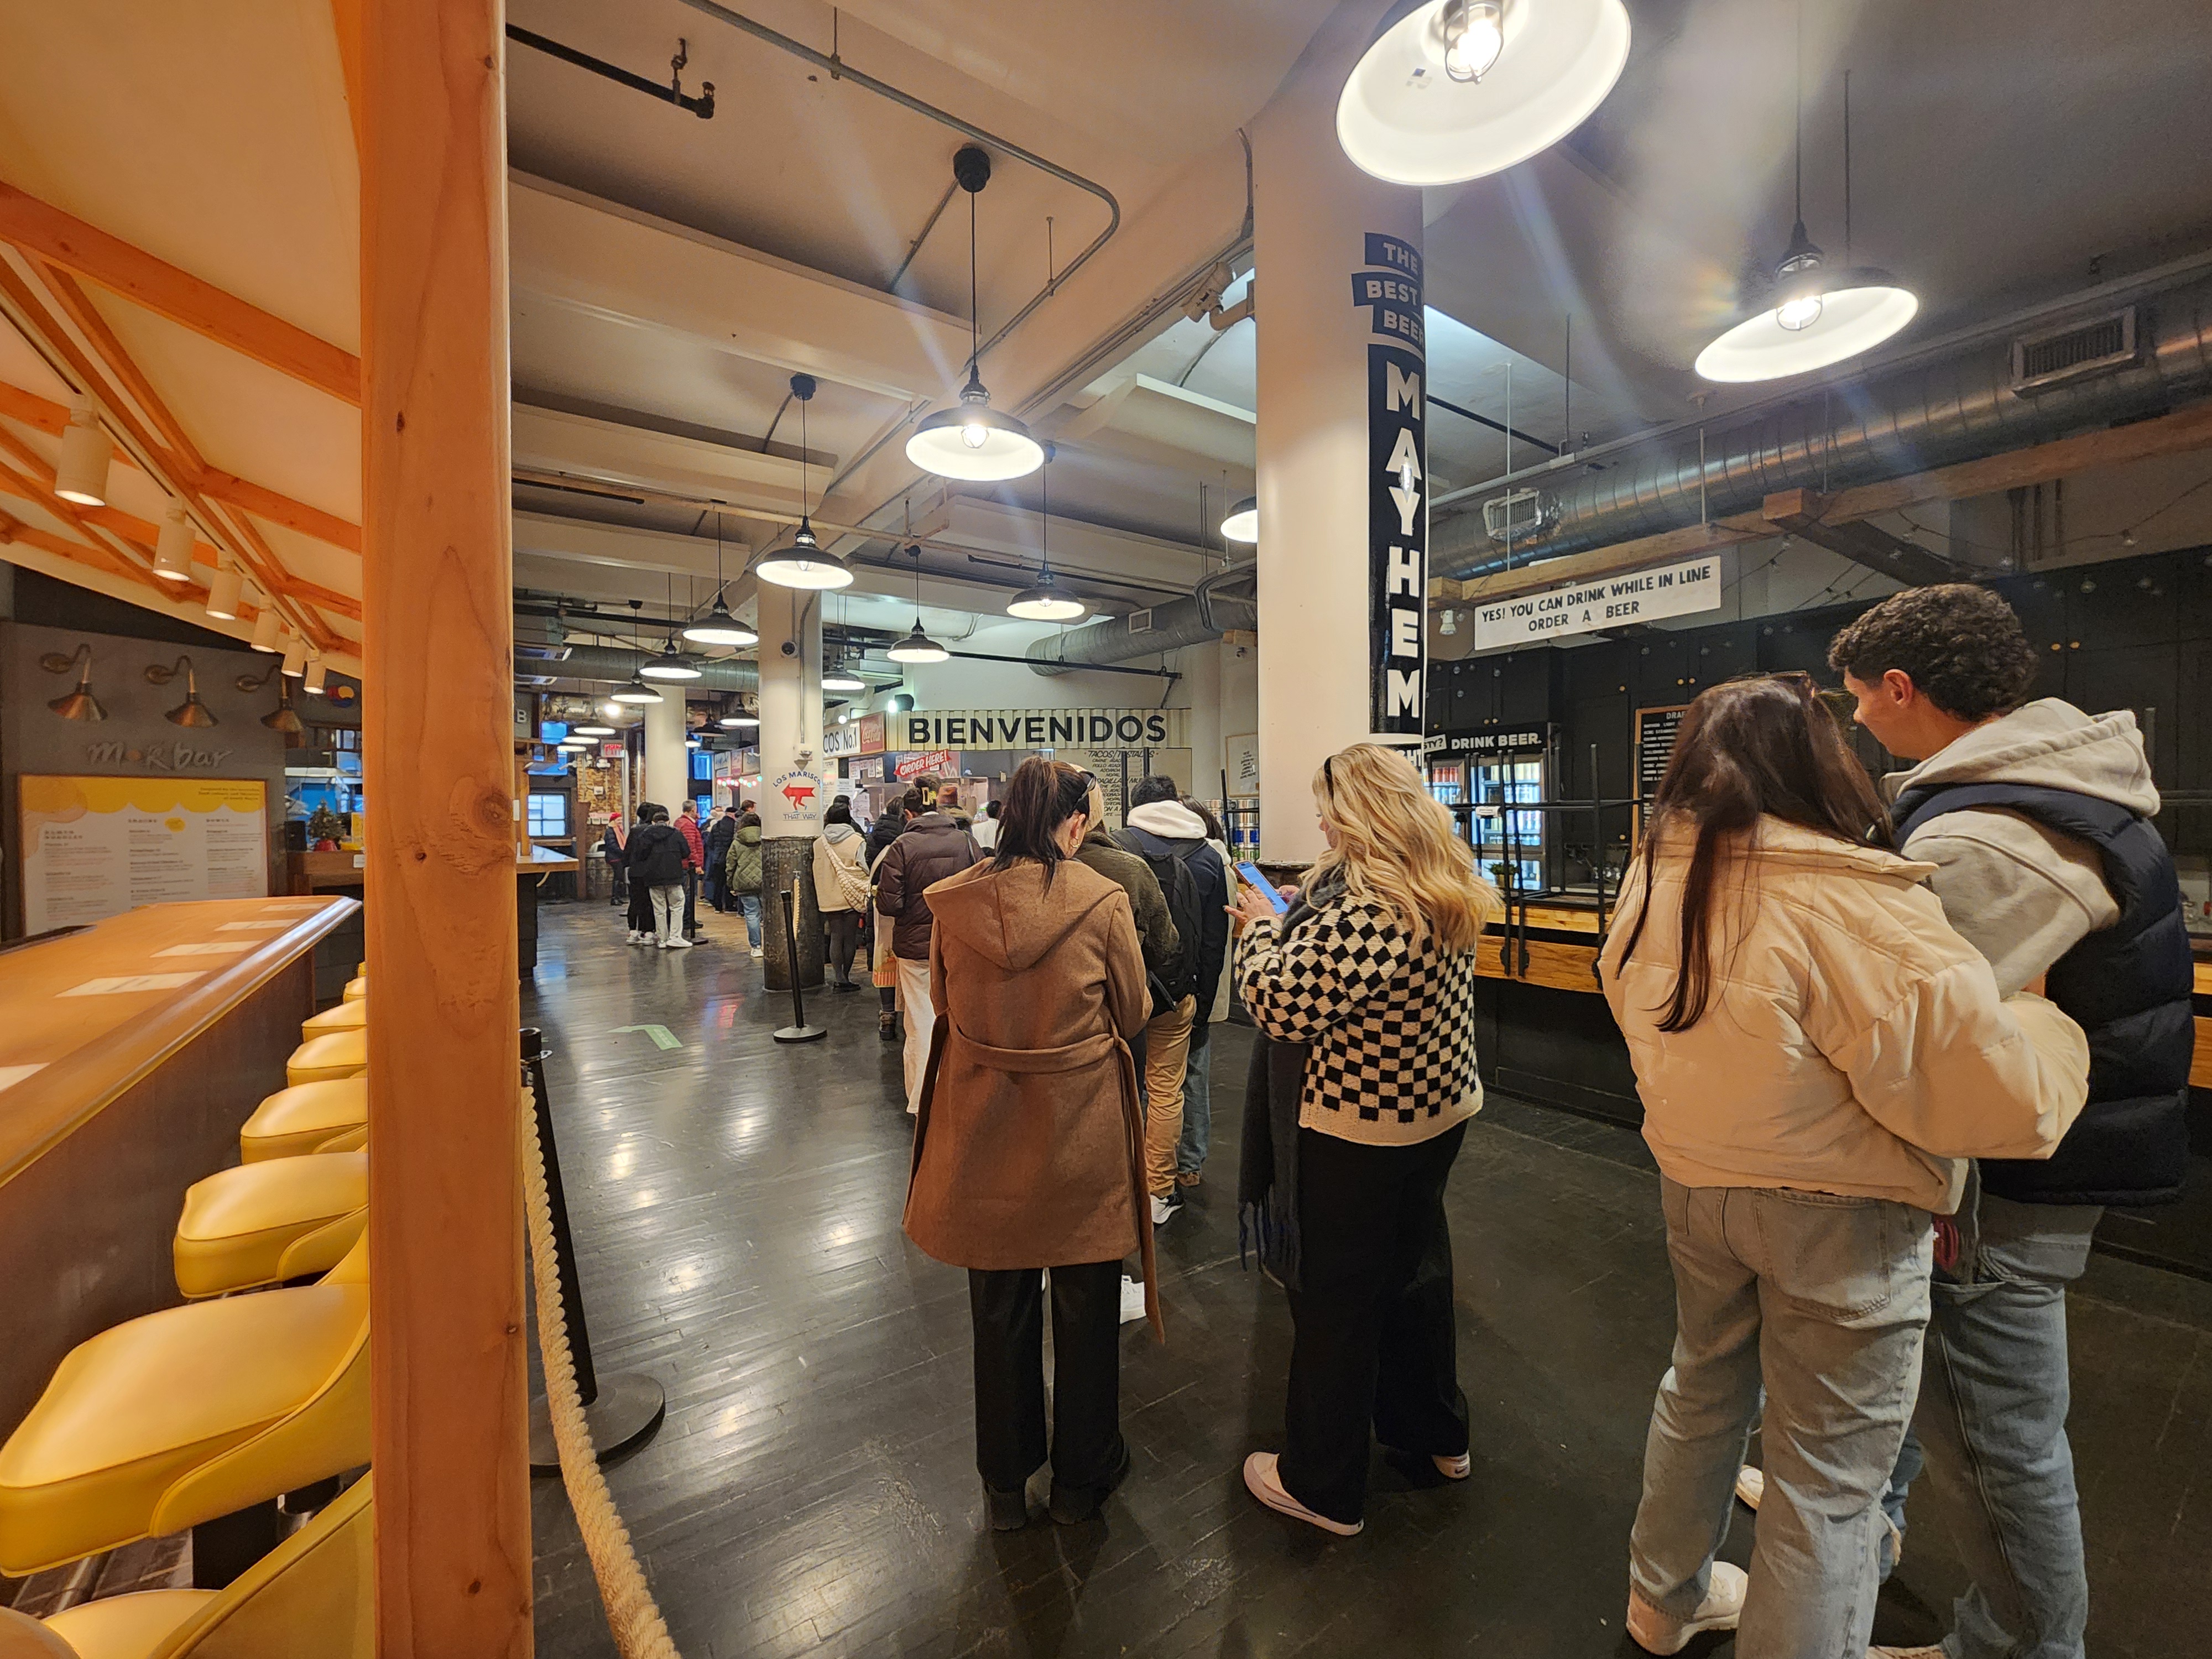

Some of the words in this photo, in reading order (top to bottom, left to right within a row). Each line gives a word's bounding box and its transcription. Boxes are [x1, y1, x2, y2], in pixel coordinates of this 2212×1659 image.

[1383, 242, 1418, 275] THE
[1366, 280, 1417, 305] BEST
[1385, 361, 1421, 718] MAYHEM
[1482, 608, 1506, 622] YES!
[1510, 603, 1533, 617] YOU
[1538, 596, 1563, 612] CAN
[1567, 586, 1605, 607] DRINK
[1610, 577, 1653, 597] WHILE
[1659, 573, 1673, 588] IN
[1679, 565, 1710, 583] LINE
[1528, 614, 1569, 632] ORDER
[1582, 611, 1592, 622] A
[1606, 601, 1640, 619] BEER
[823, 731, 839, 753] COS
[843, 727, 857, 750] No.1
[909, 716, 1166, 744] BIENVENIDOS
[1452, 735, 1495, 749] DRINK
[1498, 733, 1542, 747] BEER.
[900, 759, 925, 776] ORDER
[925, 750, 947, 767] HERE!
[773, 775, 787, 787] LOS
[789, 771, 821, 789] MARISCO
